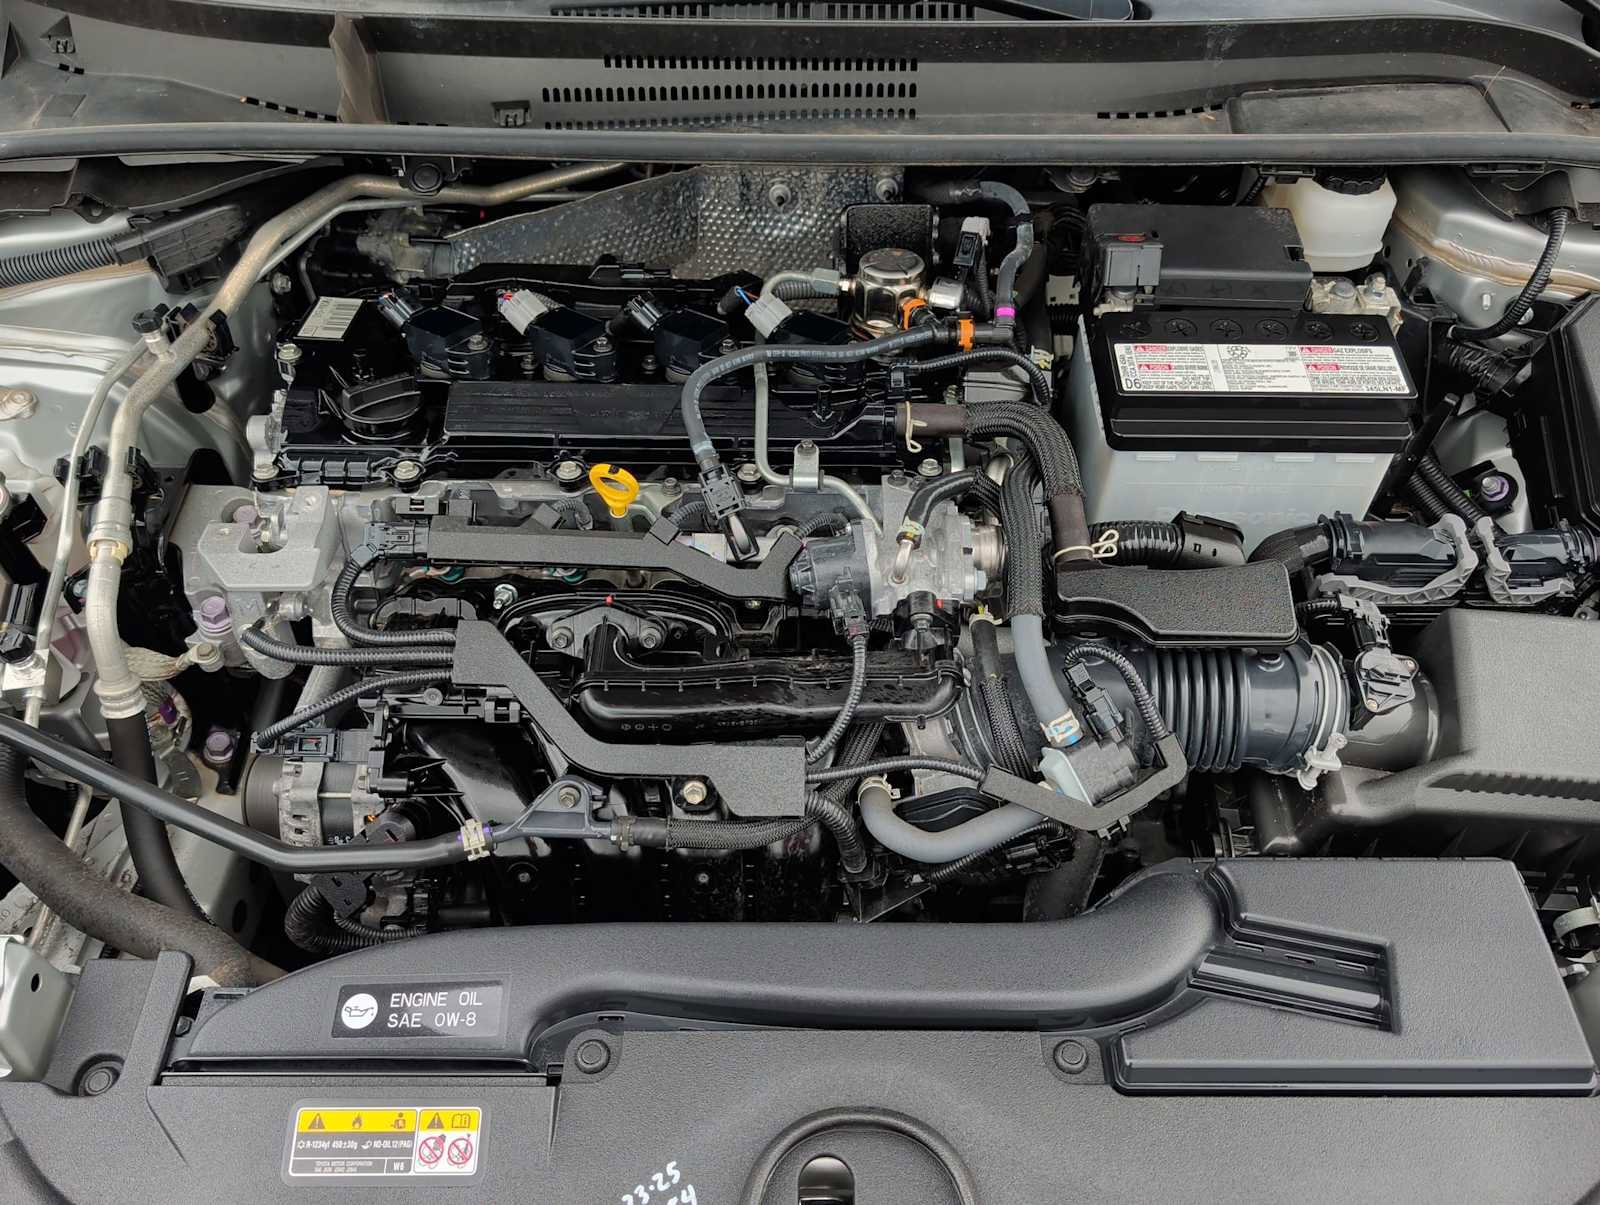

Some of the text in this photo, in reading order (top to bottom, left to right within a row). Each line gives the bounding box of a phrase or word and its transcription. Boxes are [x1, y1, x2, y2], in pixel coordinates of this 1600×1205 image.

[1125, 378, 1142, 389] D6
[390, 991, 483, 1008] ENGINE OIL
[387, 1011, 477, 1028] SAE 0W-8
